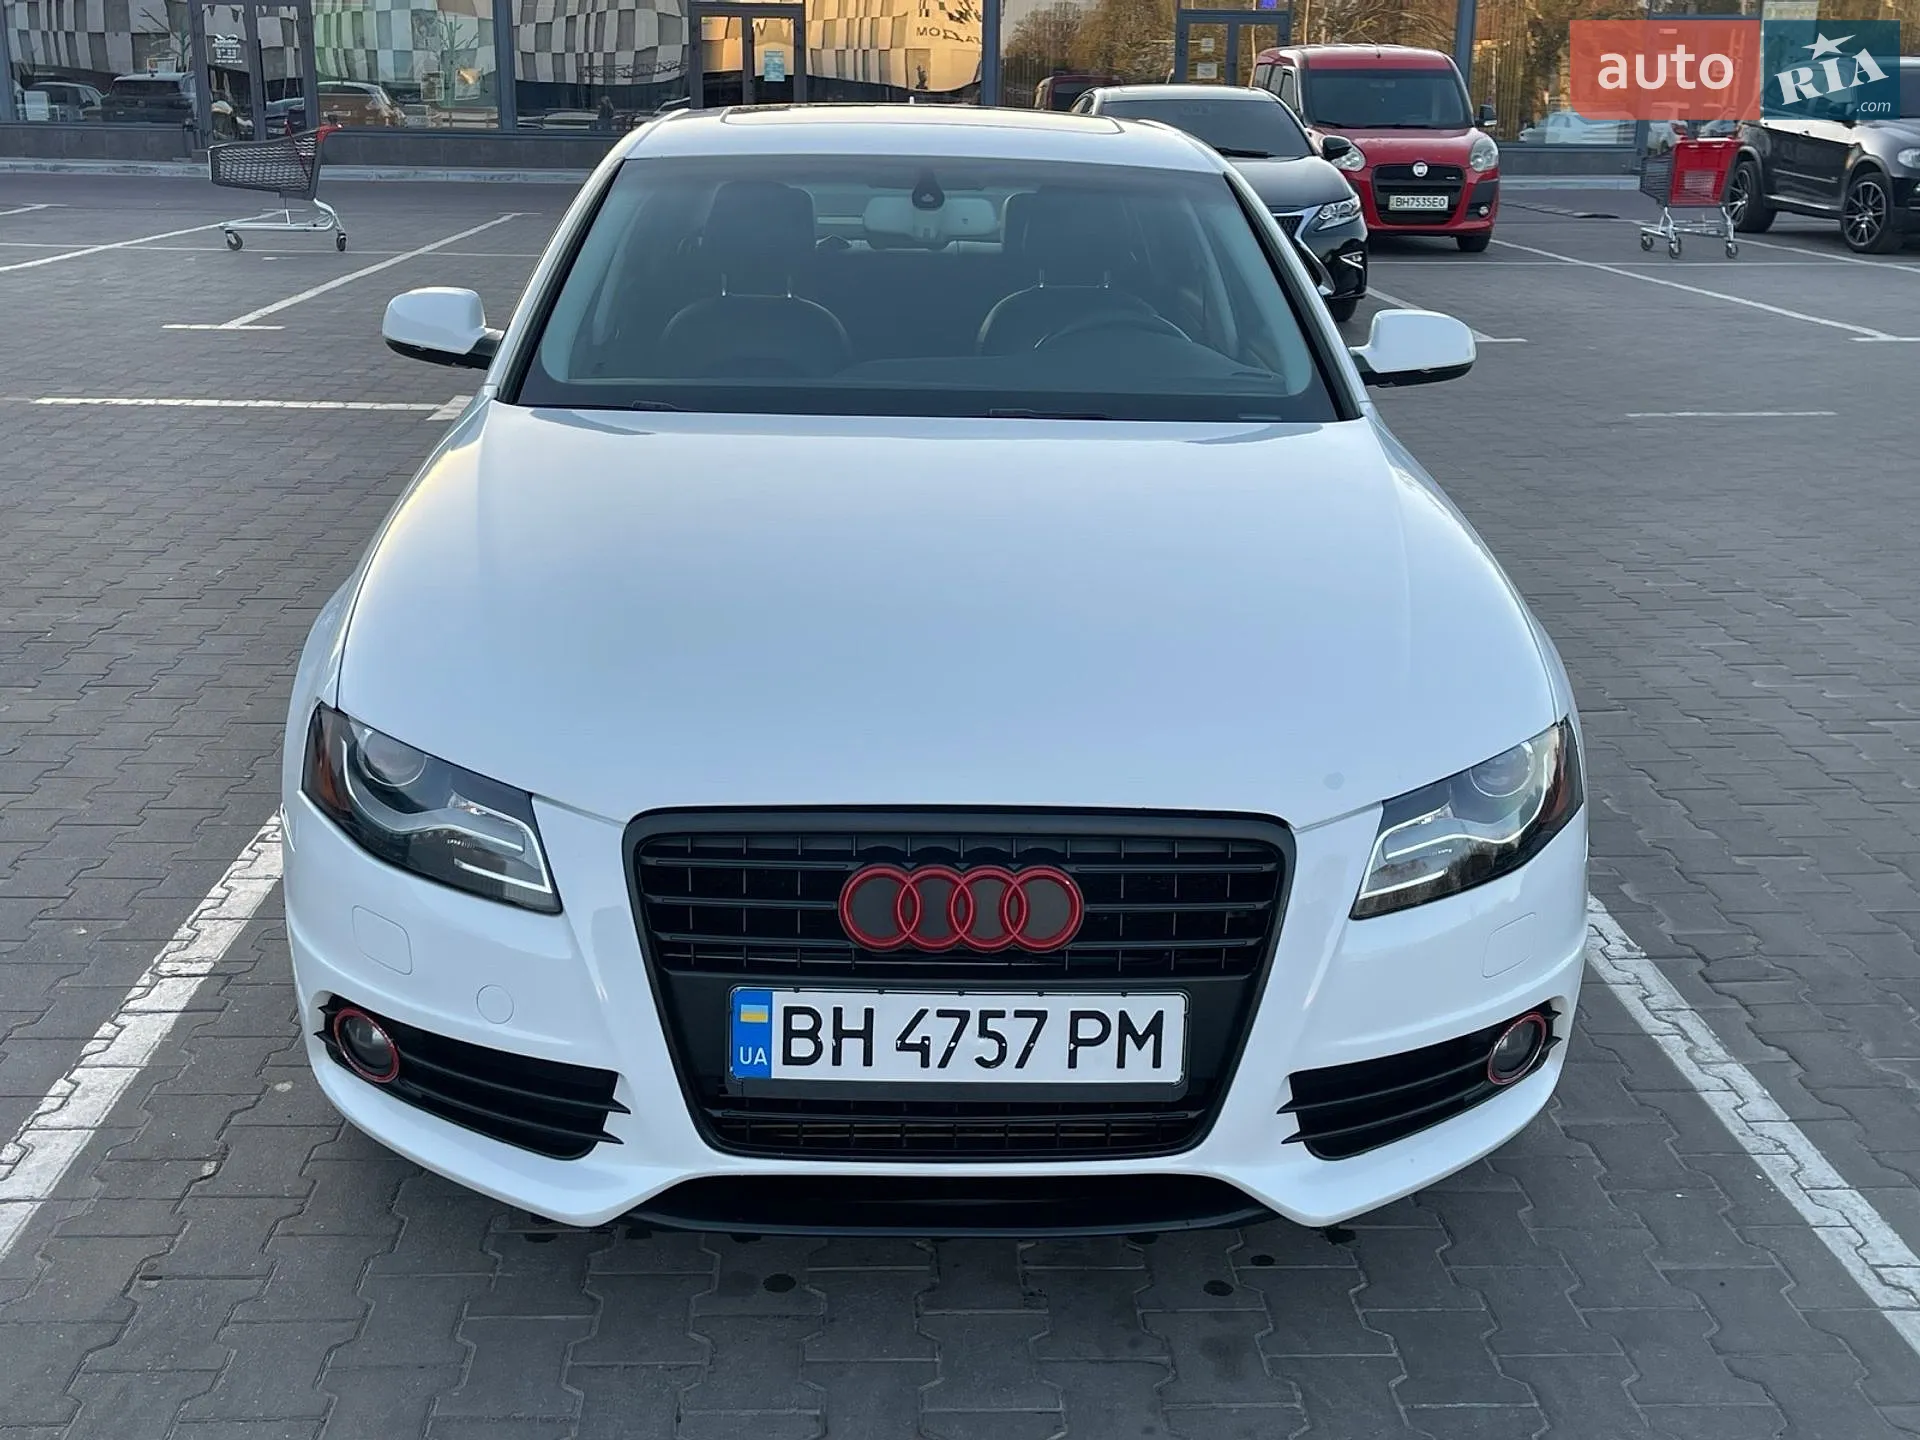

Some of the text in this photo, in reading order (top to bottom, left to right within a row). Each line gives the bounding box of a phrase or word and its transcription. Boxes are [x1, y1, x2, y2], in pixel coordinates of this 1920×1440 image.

[739, 1046, 767, 1066] UA
[781, 1006, 1165, 1069] BH 4757 PM
